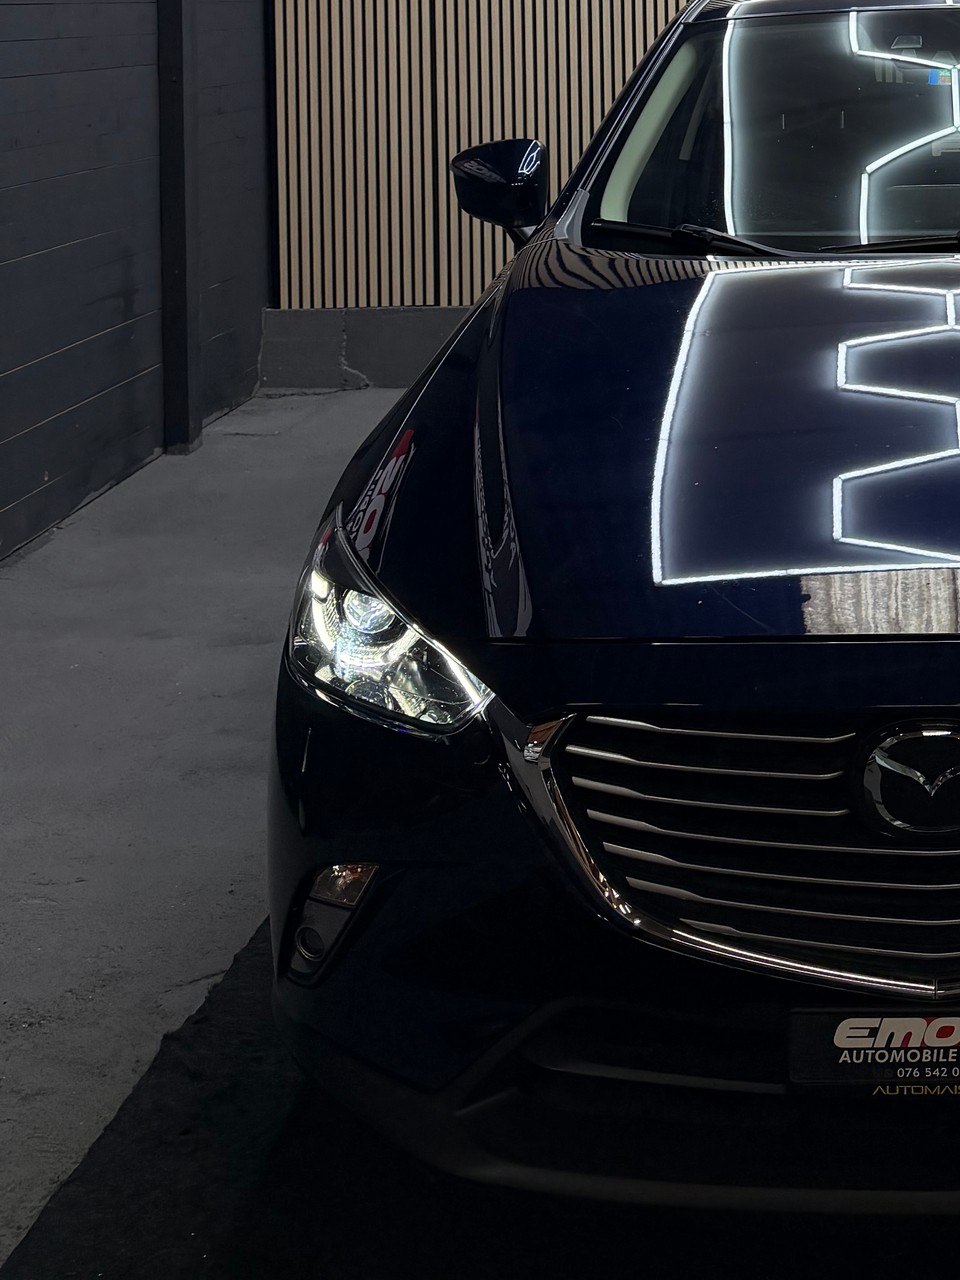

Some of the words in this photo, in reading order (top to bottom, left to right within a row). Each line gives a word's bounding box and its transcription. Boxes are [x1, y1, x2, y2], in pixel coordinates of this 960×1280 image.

[838, 1048, 958, 1064] AUTOMOBILE
[896, 1067, 920, 1078] 076
[925, 1067, 948, 1078] 542
